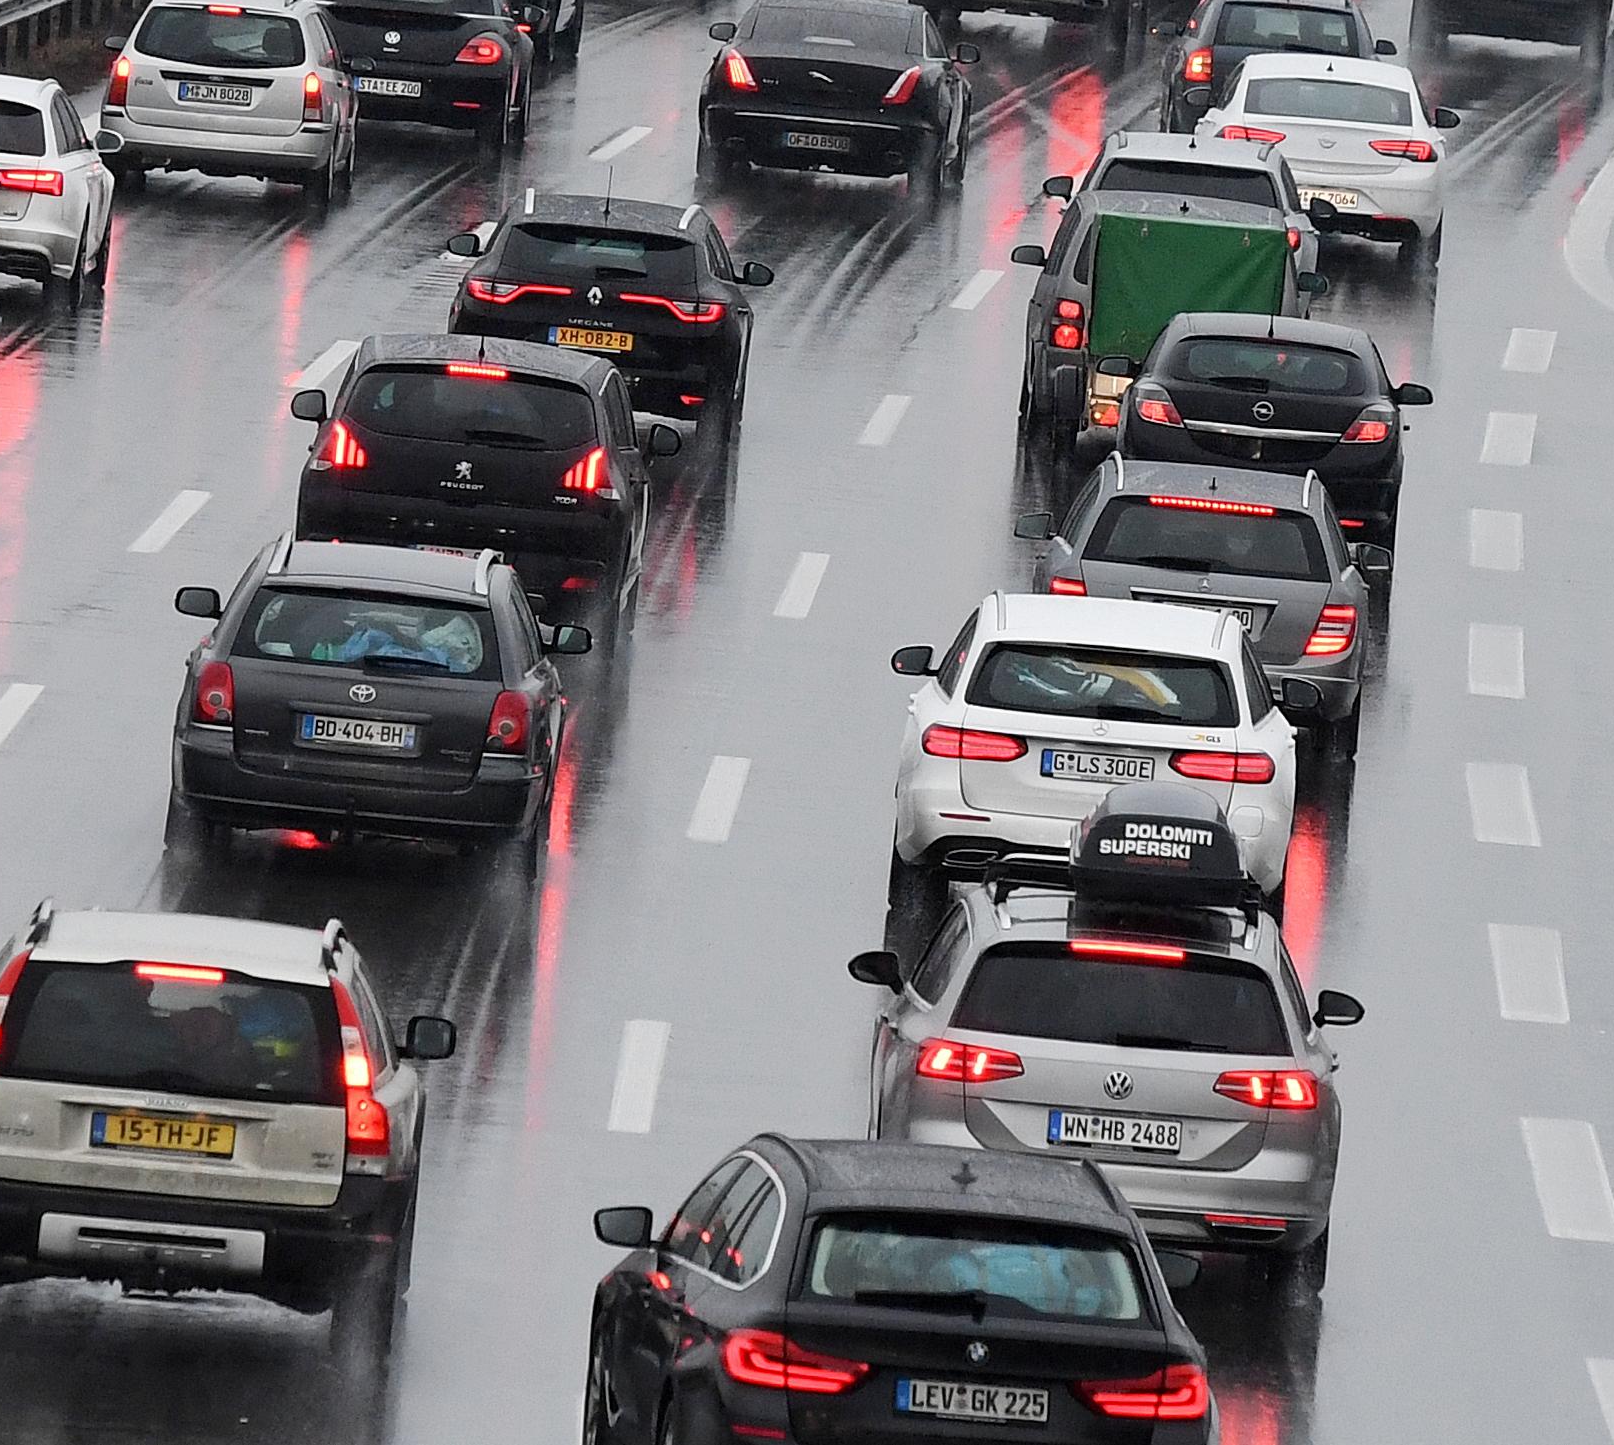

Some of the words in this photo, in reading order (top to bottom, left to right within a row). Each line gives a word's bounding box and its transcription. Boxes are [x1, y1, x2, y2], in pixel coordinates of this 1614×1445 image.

[201, 87, 217, 98] JN
[220, 88, 249, 101] 8028
[360, 79, 379, 91] STA
[386, 81, 398, 93] EE
[400, 82, 419, 94] 200
[559, 328, 628, 348] XH-082-B
[314, 719, 404, 744] BD-404-BH
[1054, 753, 1066, 771] G
[1076, 756, 1100, 774] LS
[1103, 758, 1151, 779] 300E
[1125, 823, 1214, 846] DOLOMITI
[1099, 839, 1191, 860] SUPERSKI
[117, 1118, 221, 1147] 15-TH-JF
[1064, 1112, 1088, 1140] WN
[1100, 1115, 1125, 1142] HB
[1130, 1121, 1178, 1147] 2488
[911, 1383, 954, 1411] LEV
[971, 1387, 998, 1415] GK
[1005, 1390, 1047, 1419] 225
